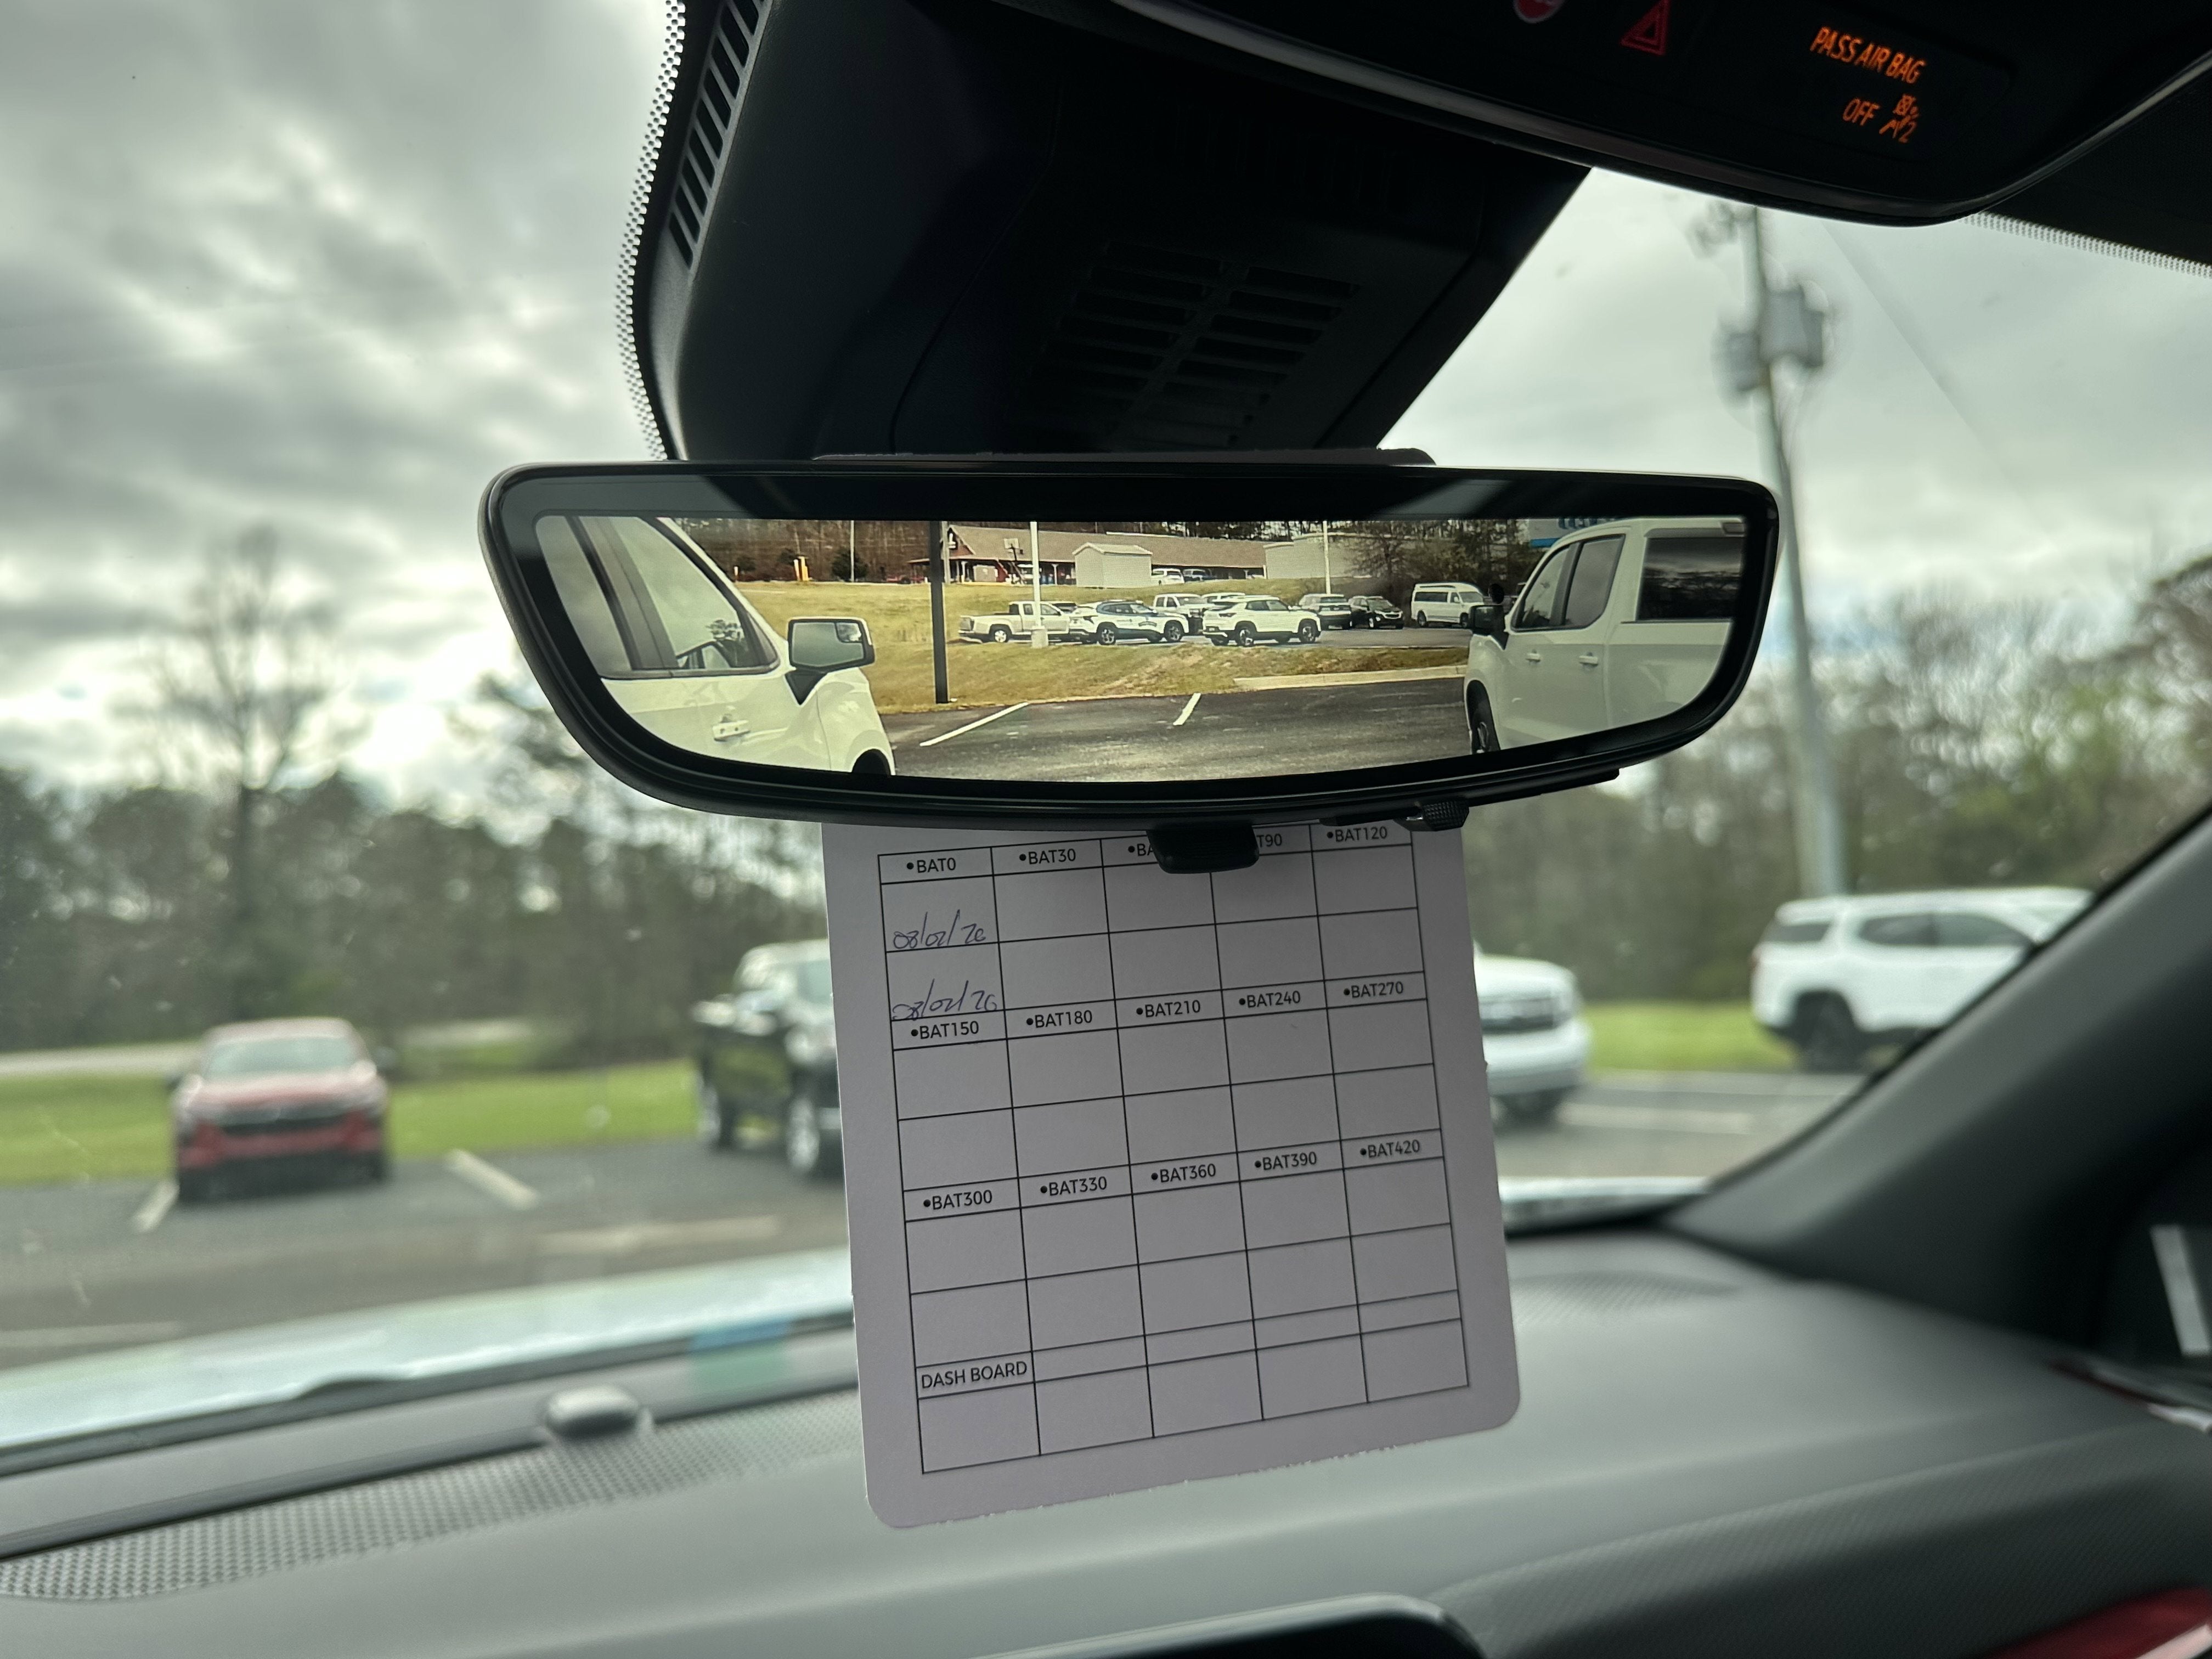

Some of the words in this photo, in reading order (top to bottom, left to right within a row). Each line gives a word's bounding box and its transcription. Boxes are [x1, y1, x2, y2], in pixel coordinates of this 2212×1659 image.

[1810, 26, 1862, 63] PASS
[1854, 43, 1891, 72] AIR
[1885, 53, 1926, 83] BAG
[1842, 98, 1880, 126] OFF
[1257, 833, 1283, 848] T90
[921, 1369, 966, 1389] DASH
[970, 1361, 1028, 1382] BOARD
